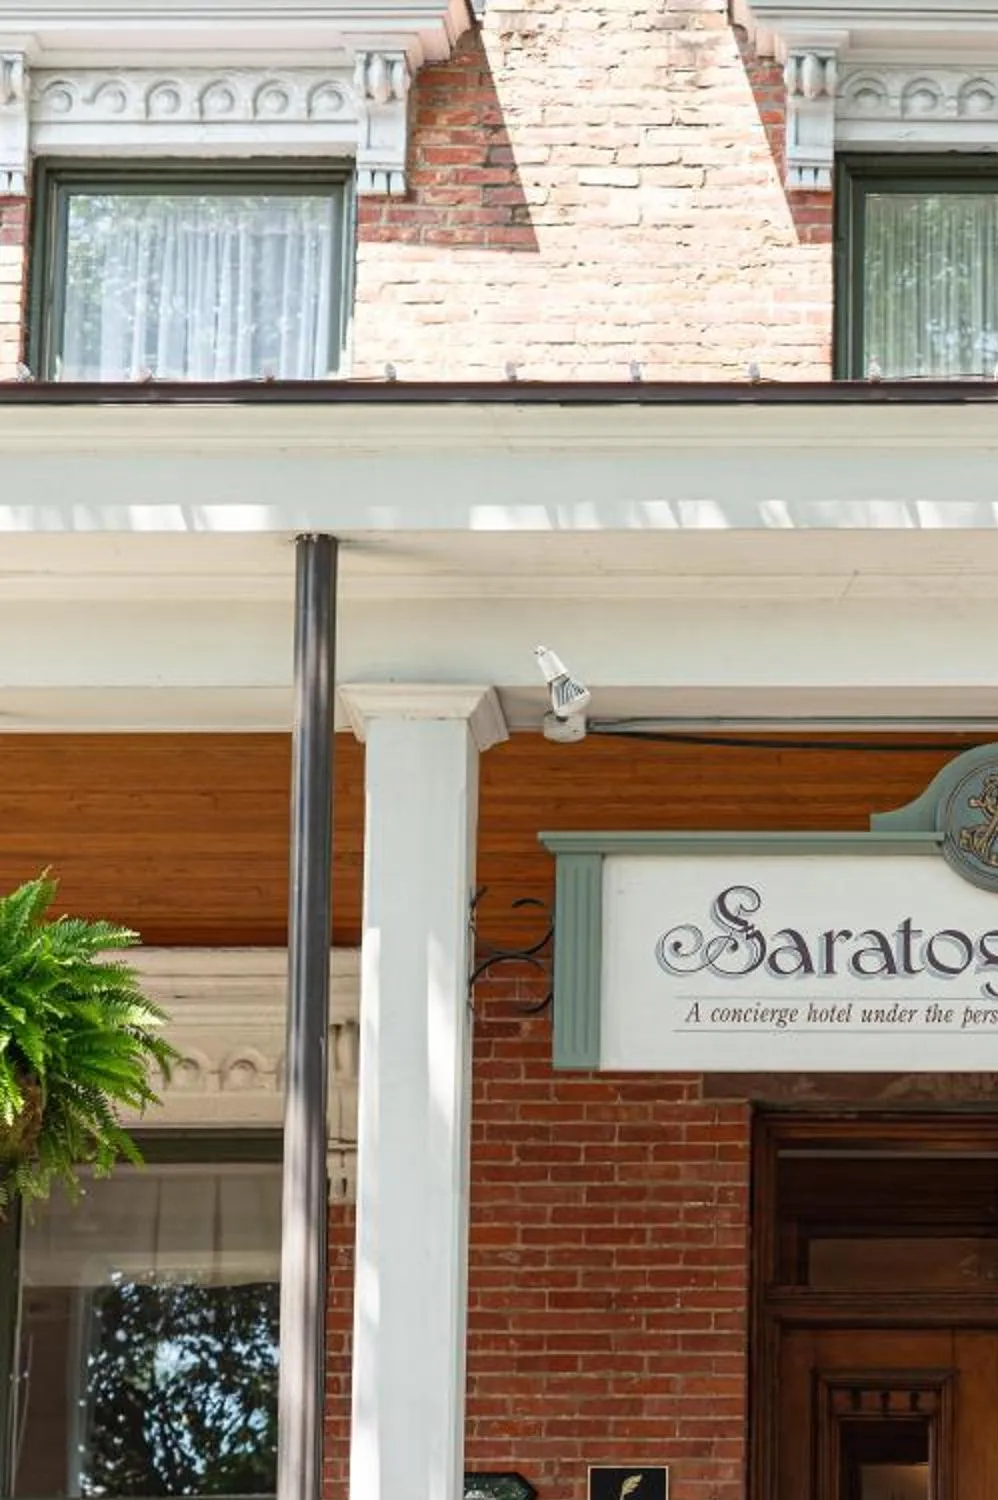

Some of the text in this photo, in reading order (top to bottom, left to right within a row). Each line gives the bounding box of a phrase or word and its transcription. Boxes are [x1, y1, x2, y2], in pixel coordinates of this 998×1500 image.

[685, 1003, 701, 1023] A
[710, 1002, 799, 1027] concierge
[807, 1002, 853, 1023] hotel
[861, 1002, 918, 1023] under
[925, 1002, 954, 1023] the
